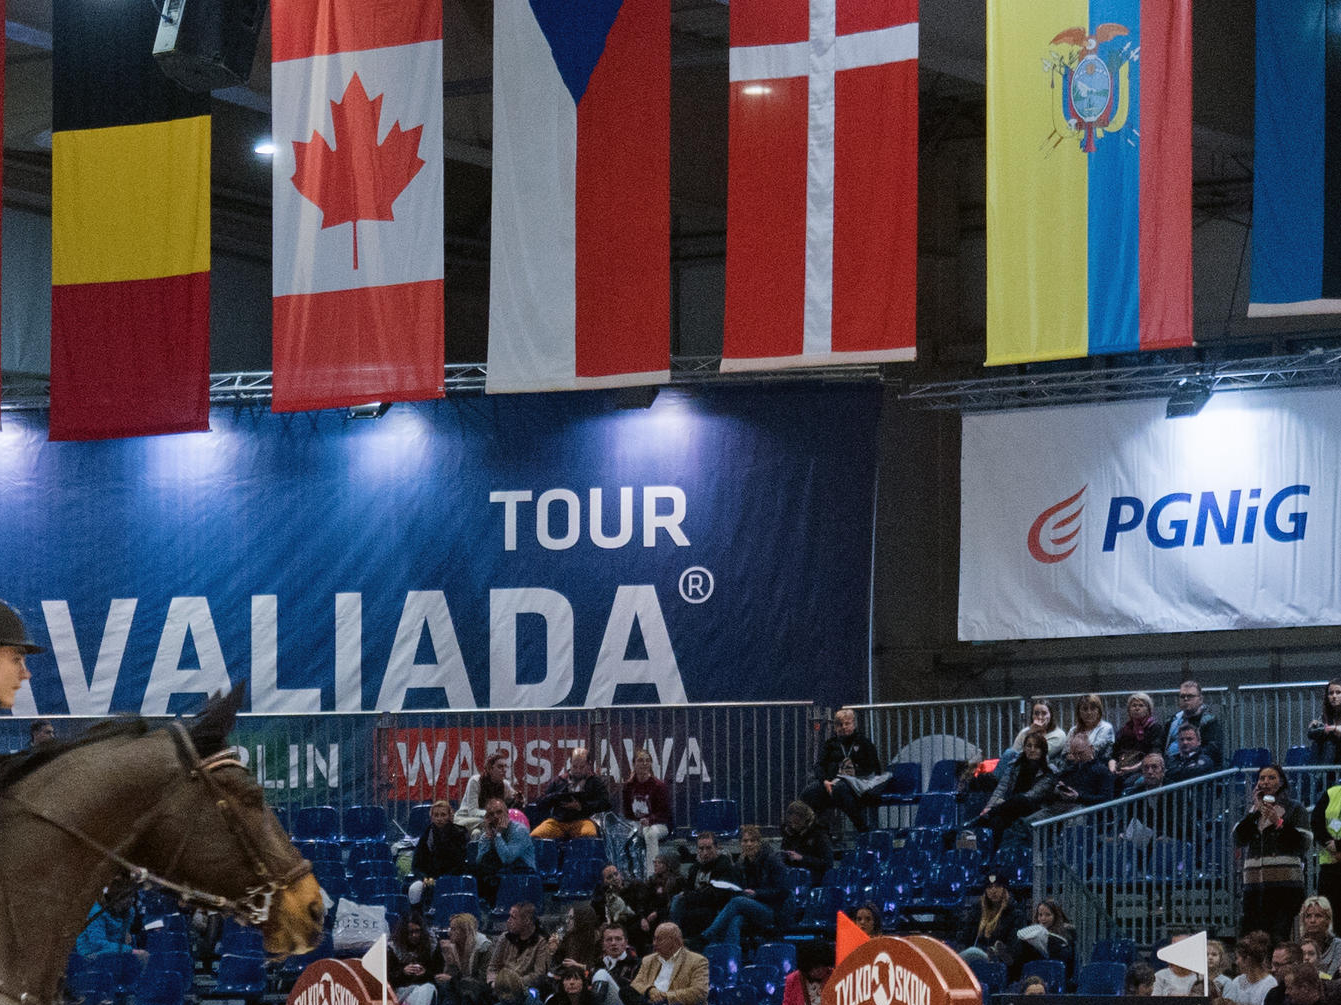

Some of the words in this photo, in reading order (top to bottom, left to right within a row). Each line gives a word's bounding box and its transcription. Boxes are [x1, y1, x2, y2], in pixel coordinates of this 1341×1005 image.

[489, 485, 691, 551] TOUR
[1102, 484, 1311, 552] PGNiG
[230, 743, 339, 789] LIN
